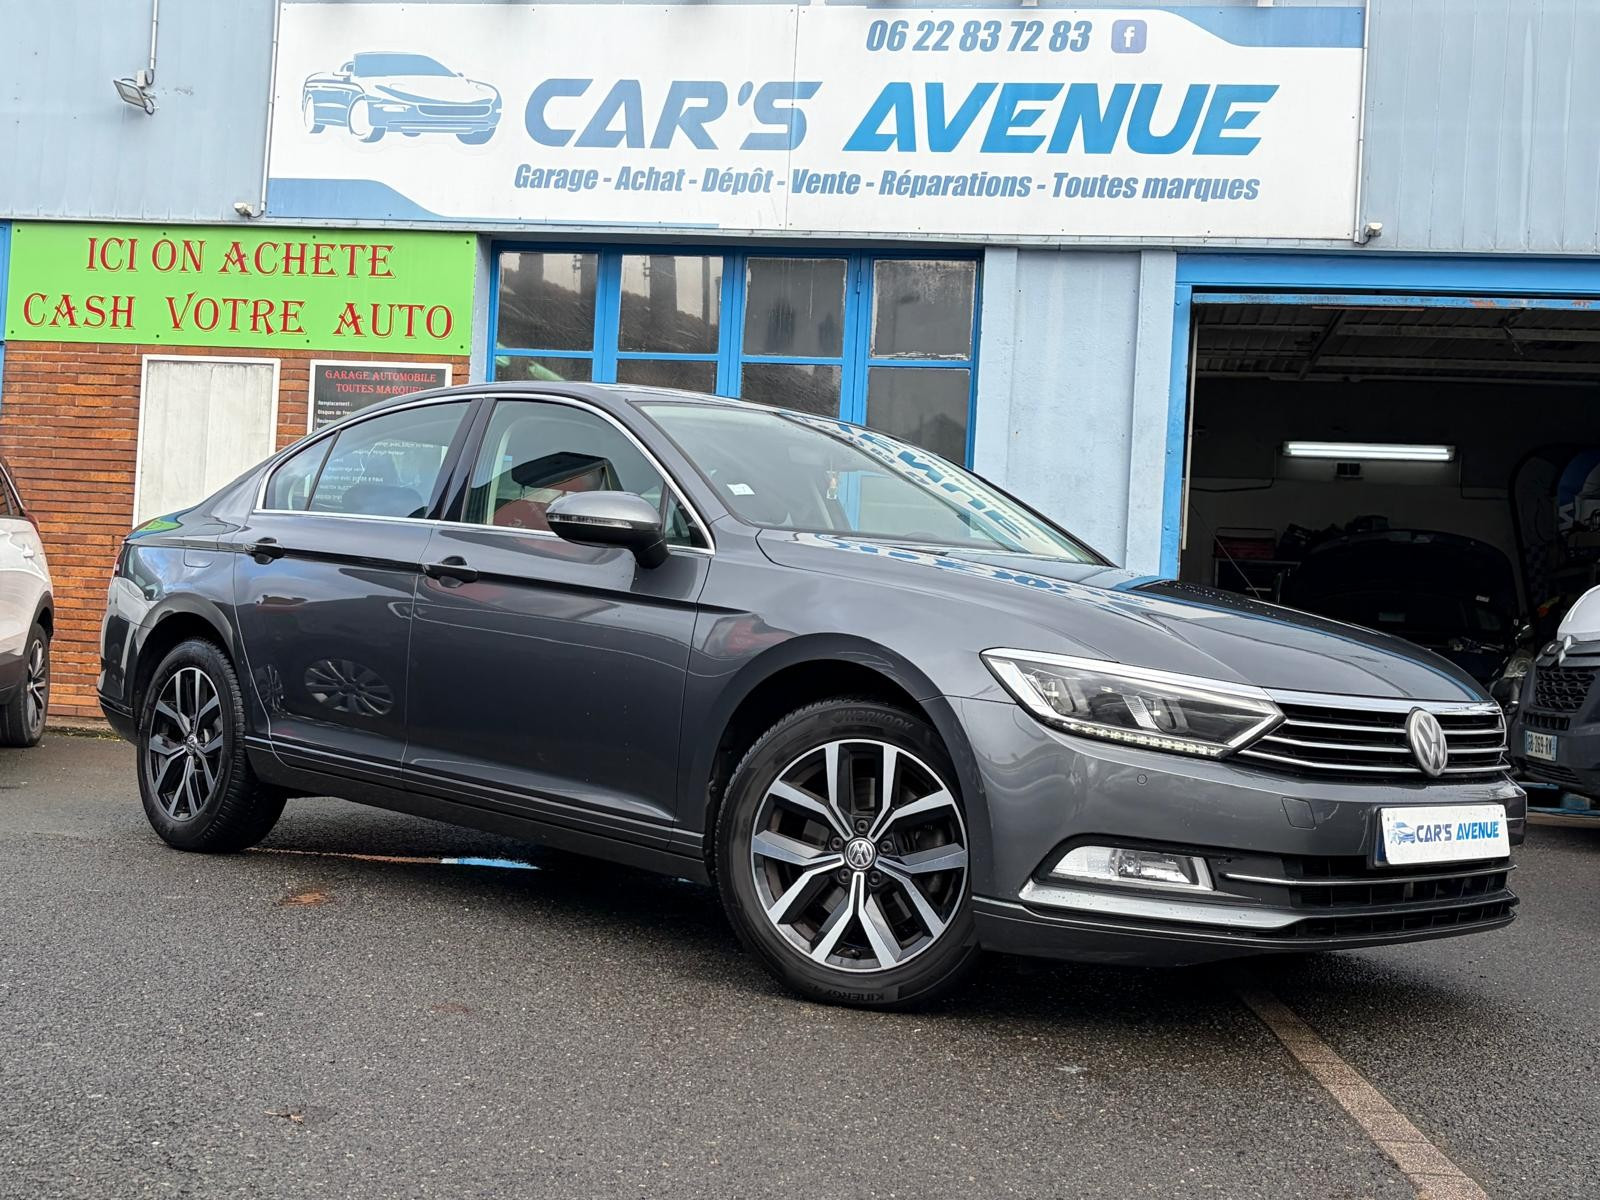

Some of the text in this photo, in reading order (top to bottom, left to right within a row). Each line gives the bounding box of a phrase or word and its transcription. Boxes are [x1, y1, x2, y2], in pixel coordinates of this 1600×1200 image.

[867, 20, 1092, 52] 06 22 83 72 83
[524, 78, 1280, 155] CAR'S AVENUE
[514, 164, 598, 191] Garage
[615, 166, 687, 192] Achat
[701, 167, 775, 196] Dépôt
[791, 168, 861, 195] Vente
[878, 170, 1032, 199] Réparations
[1052, 172, 1138, 199] Toutes
[1142, 177, 1260, 201] marques
[87, 237, 395, 279] ICI ON ACHETE
[23, 292, 454, 339] CASH VOTRE AUTO
[325, 370, 437, 383] GARAGE AUTOMOBILE
[335, 383, 374, 393] TOUTES
[1416, 821, 1500, 843] CAR'S AVENUE
